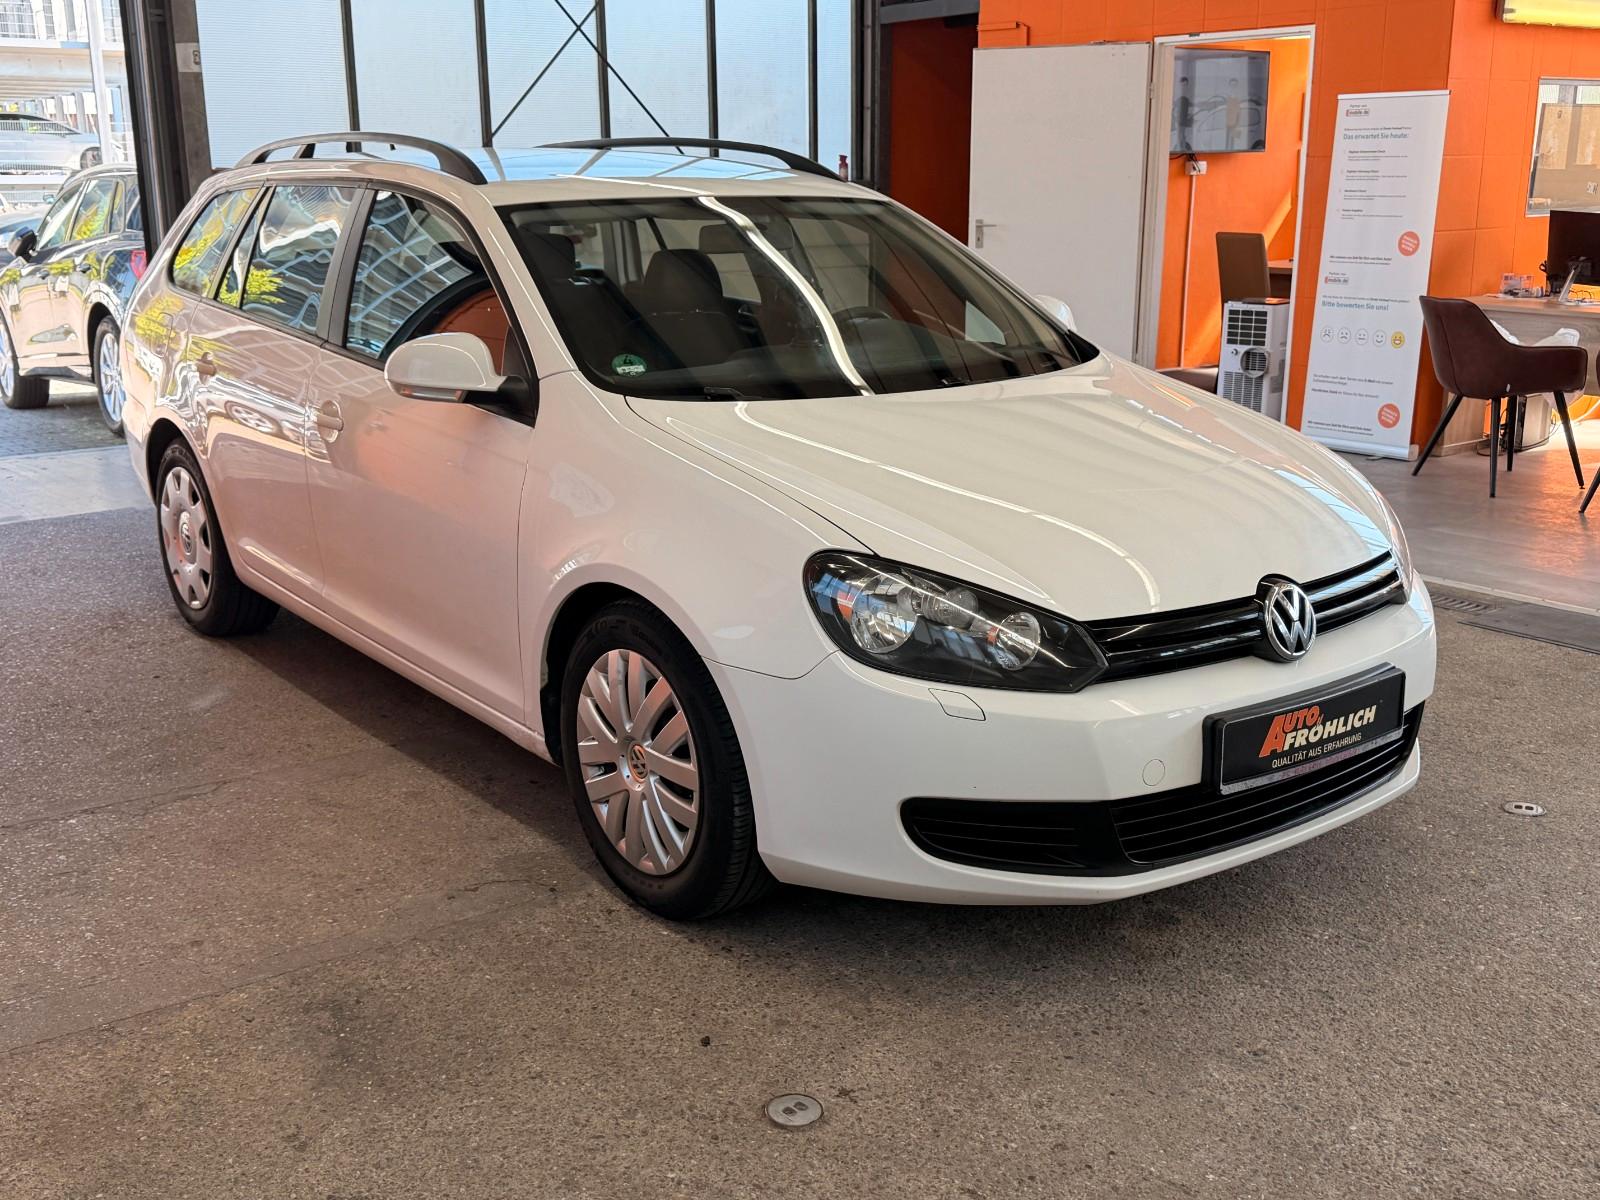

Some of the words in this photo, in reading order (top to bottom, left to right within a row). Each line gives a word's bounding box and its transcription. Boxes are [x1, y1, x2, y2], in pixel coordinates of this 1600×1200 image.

[1321, 300, 1335, 308] Bitte
[1336, 301, 1365, 309] bewerten
[1258, 705, 1320, 758] AUTO
[1284, 704, 1377, 751] FRÖHLICH
[1272, 750, 1309, 769] QUALITÄT
[1308, 745, 1322, 760] AUS
[1323, 732, 1362, 754] ERFAHRUNG
